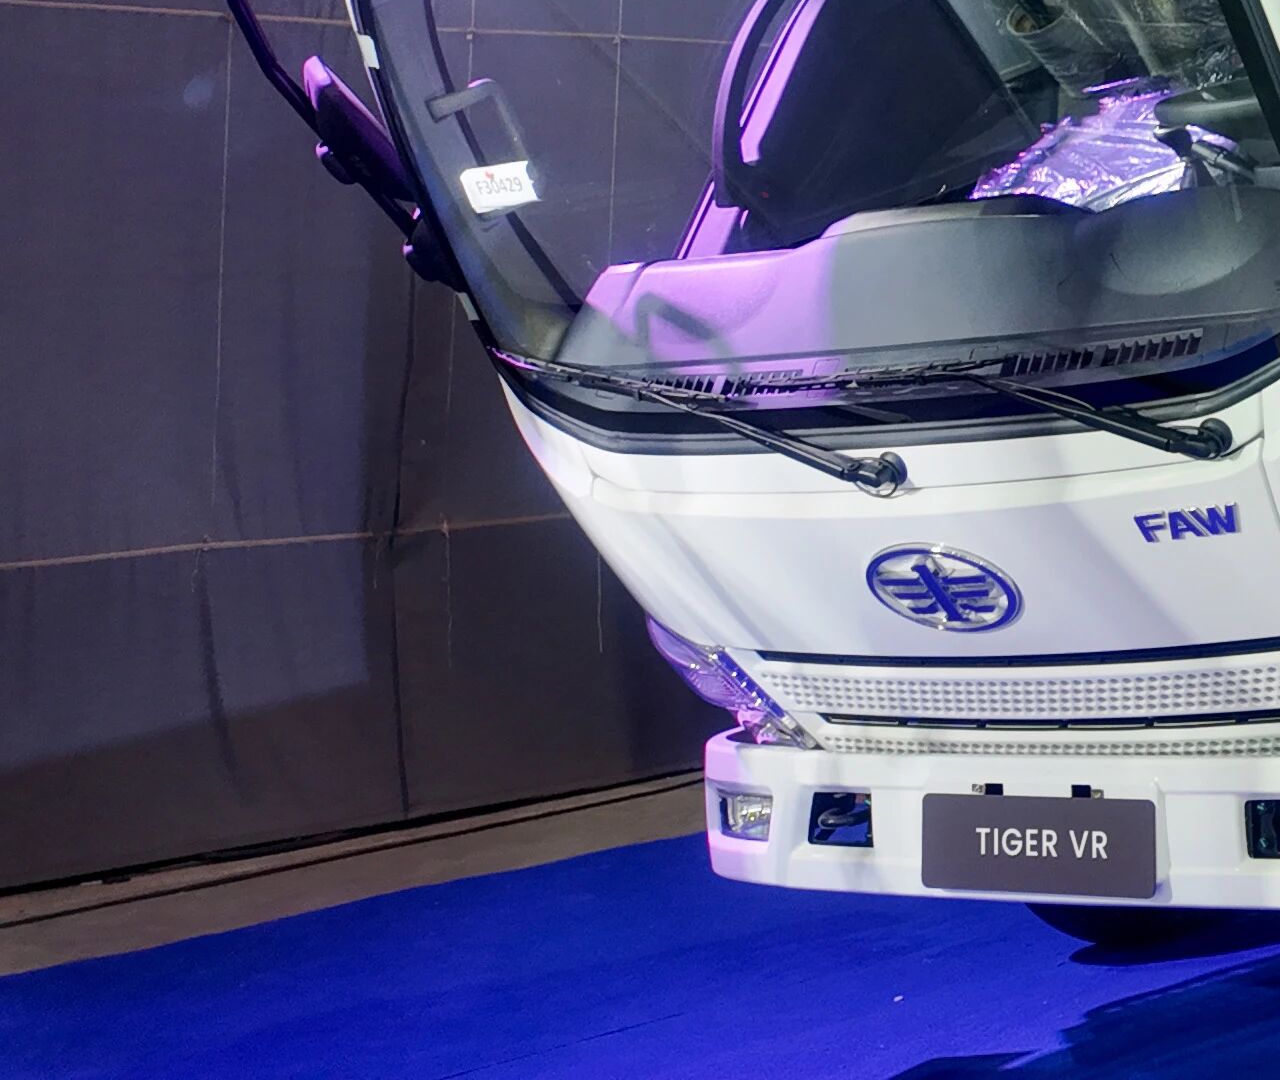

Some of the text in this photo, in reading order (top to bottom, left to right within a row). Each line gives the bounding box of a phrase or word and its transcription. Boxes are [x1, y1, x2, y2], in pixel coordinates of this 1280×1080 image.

[1134, 502, 1241, 542] FAW
[976, 827, 1108, 859] TIGER VR
